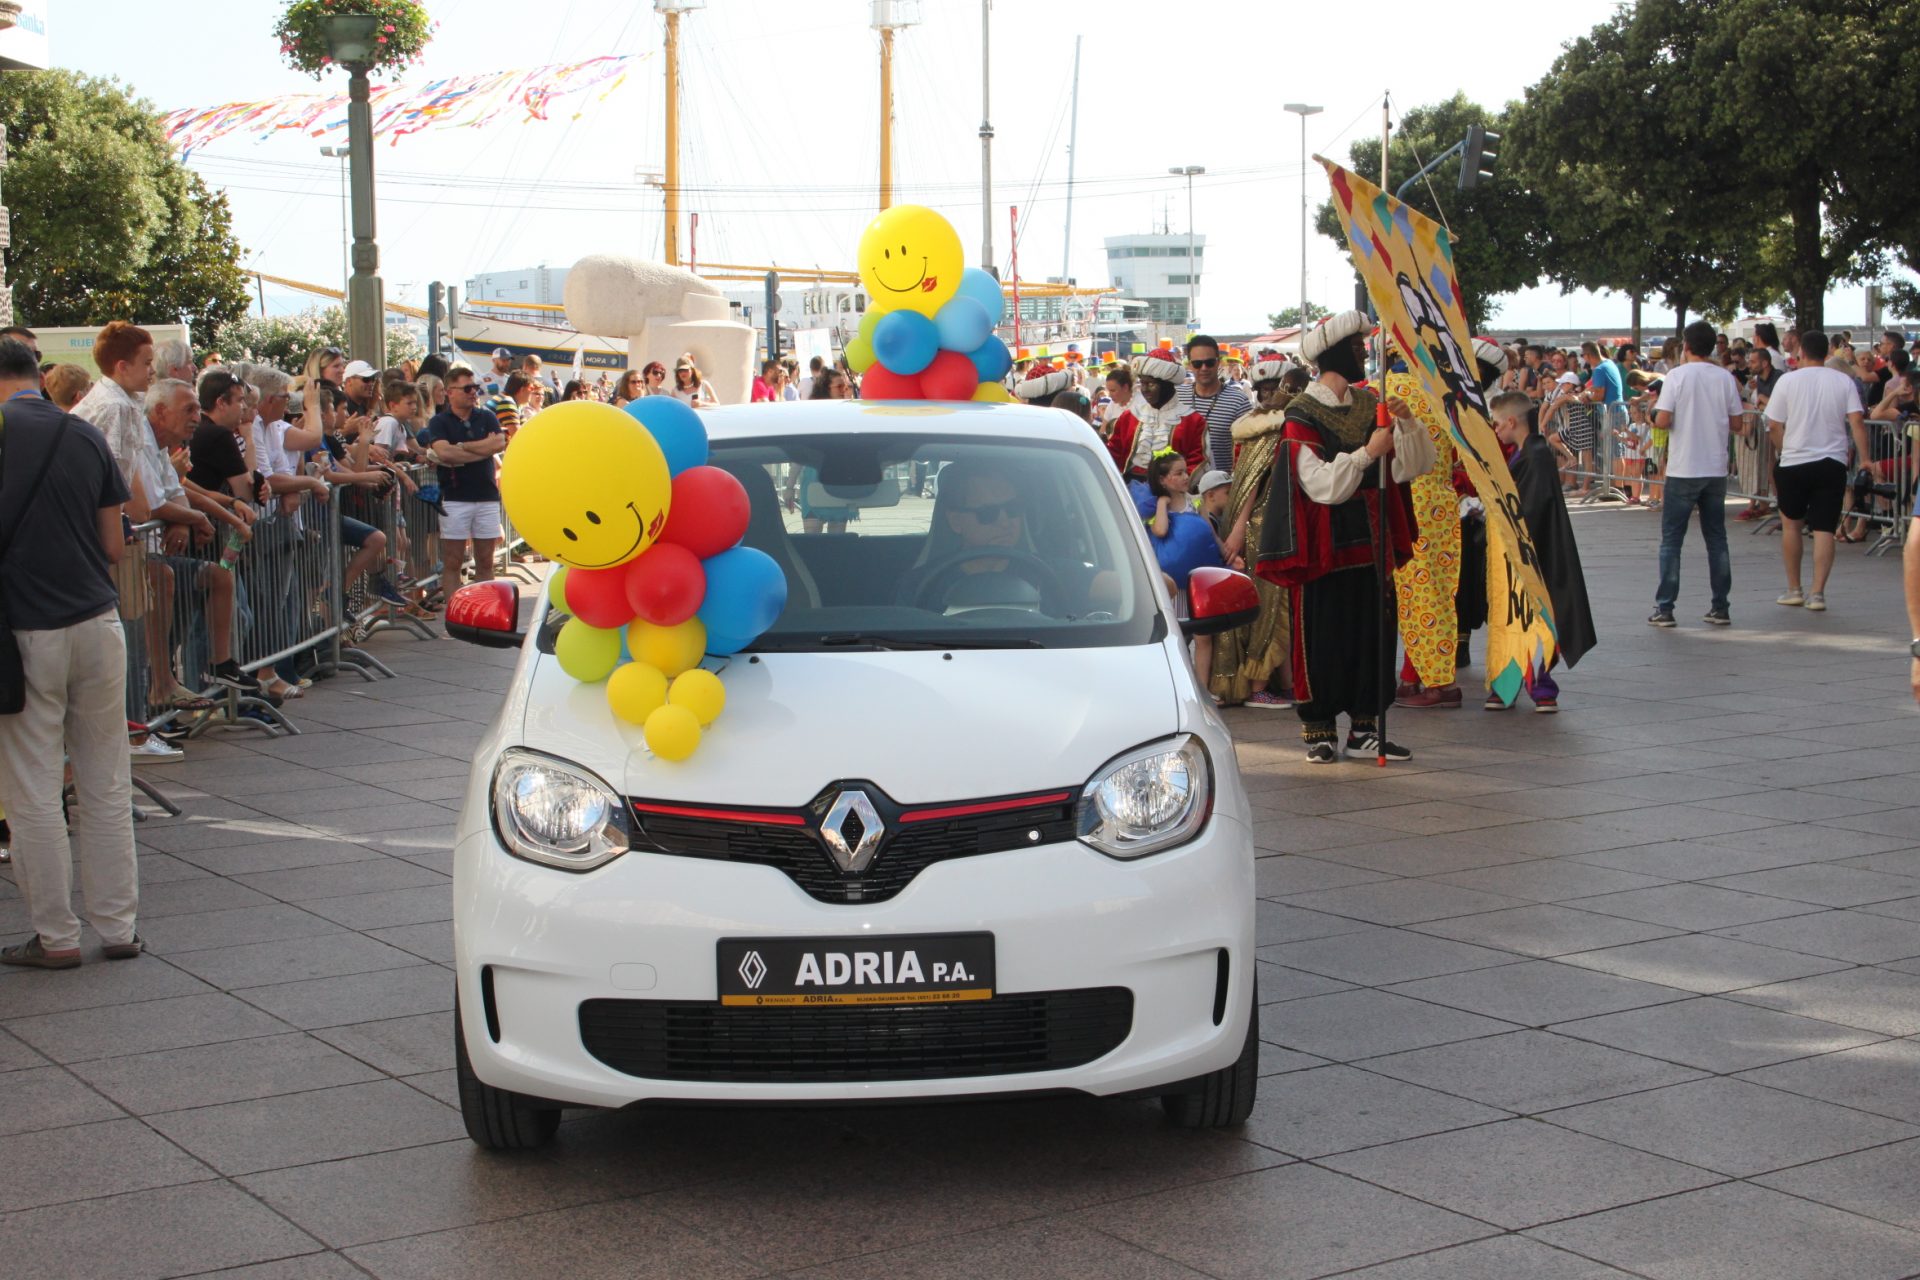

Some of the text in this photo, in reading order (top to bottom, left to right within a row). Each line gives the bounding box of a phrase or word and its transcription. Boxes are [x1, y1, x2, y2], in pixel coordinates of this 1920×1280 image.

[69, 338, 96, 348] RIJE
[585, 356, 607, 364] MORA
[795, 950, 975, 986] ADRIA P.A.
[803, 995, 834, 1003] ADRIA
